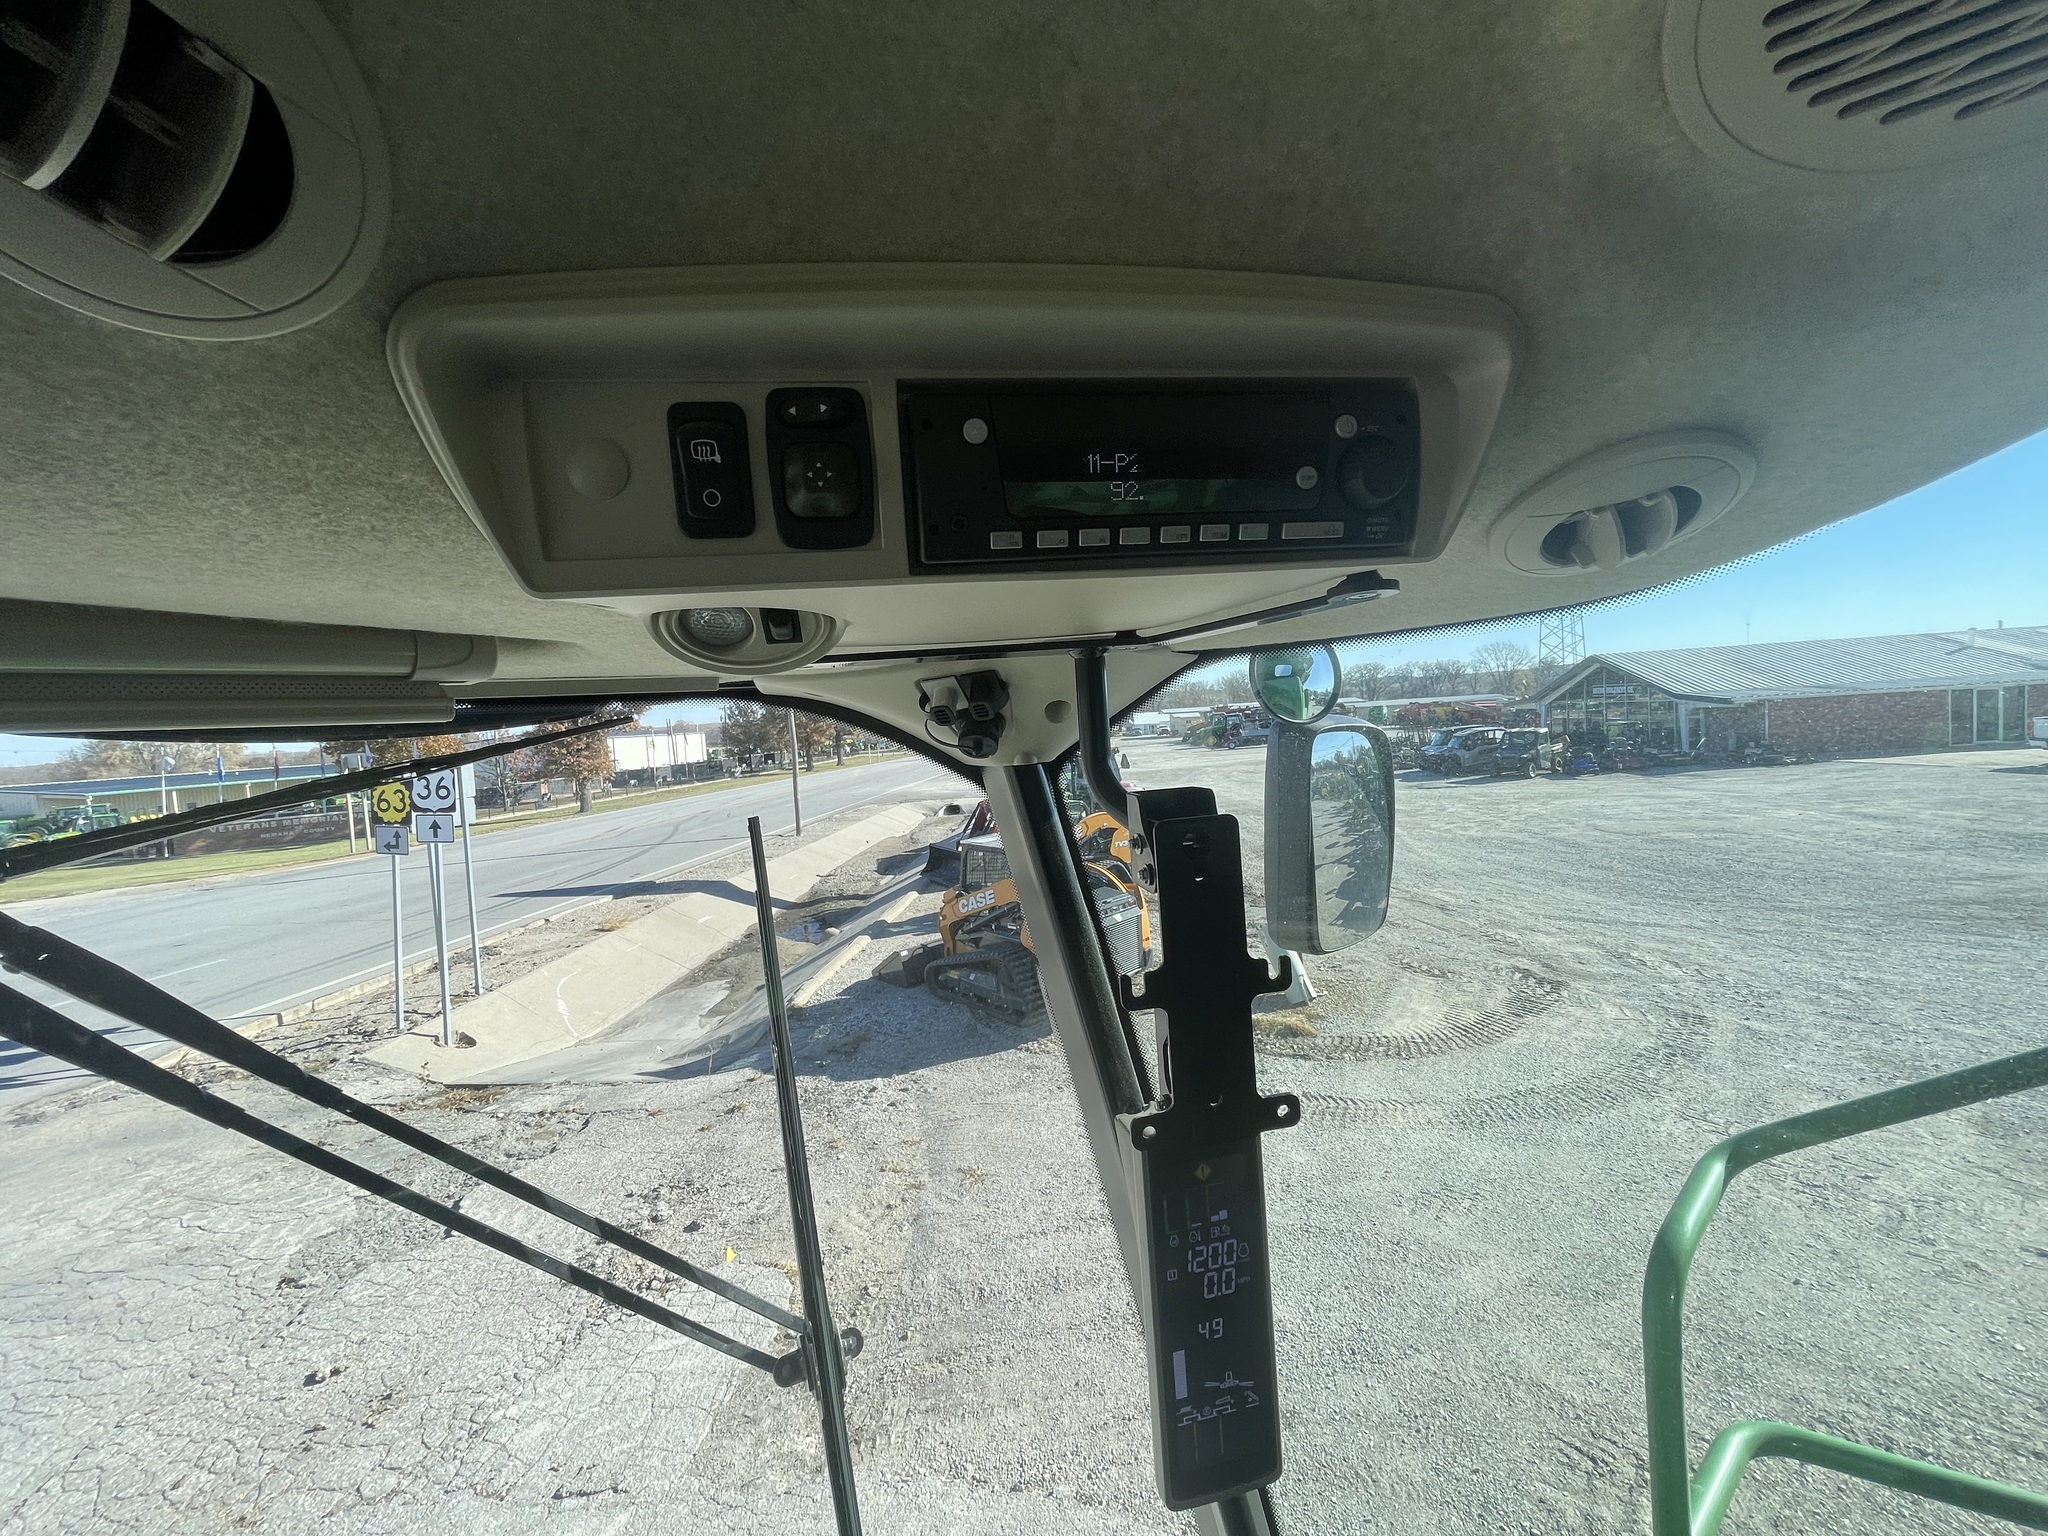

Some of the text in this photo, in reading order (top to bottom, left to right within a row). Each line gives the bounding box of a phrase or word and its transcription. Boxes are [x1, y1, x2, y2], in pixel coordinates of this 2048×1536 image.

[376, 788, 407, 814] 63
[416, 775, 451, 801] 36
[209, 821, 278, 833] VETERANS
[282, 814, 347, 827] MEMORIAL
[260, 826, 336, 839] NEMAHA COUNTY
[958, 888, 996, 914] CASE
[1187, 1238, 1238, 1274] 1200
[1203, 1267, 1236, 1300] 0.0
[1198, 1317, 1223, 1340] 49
